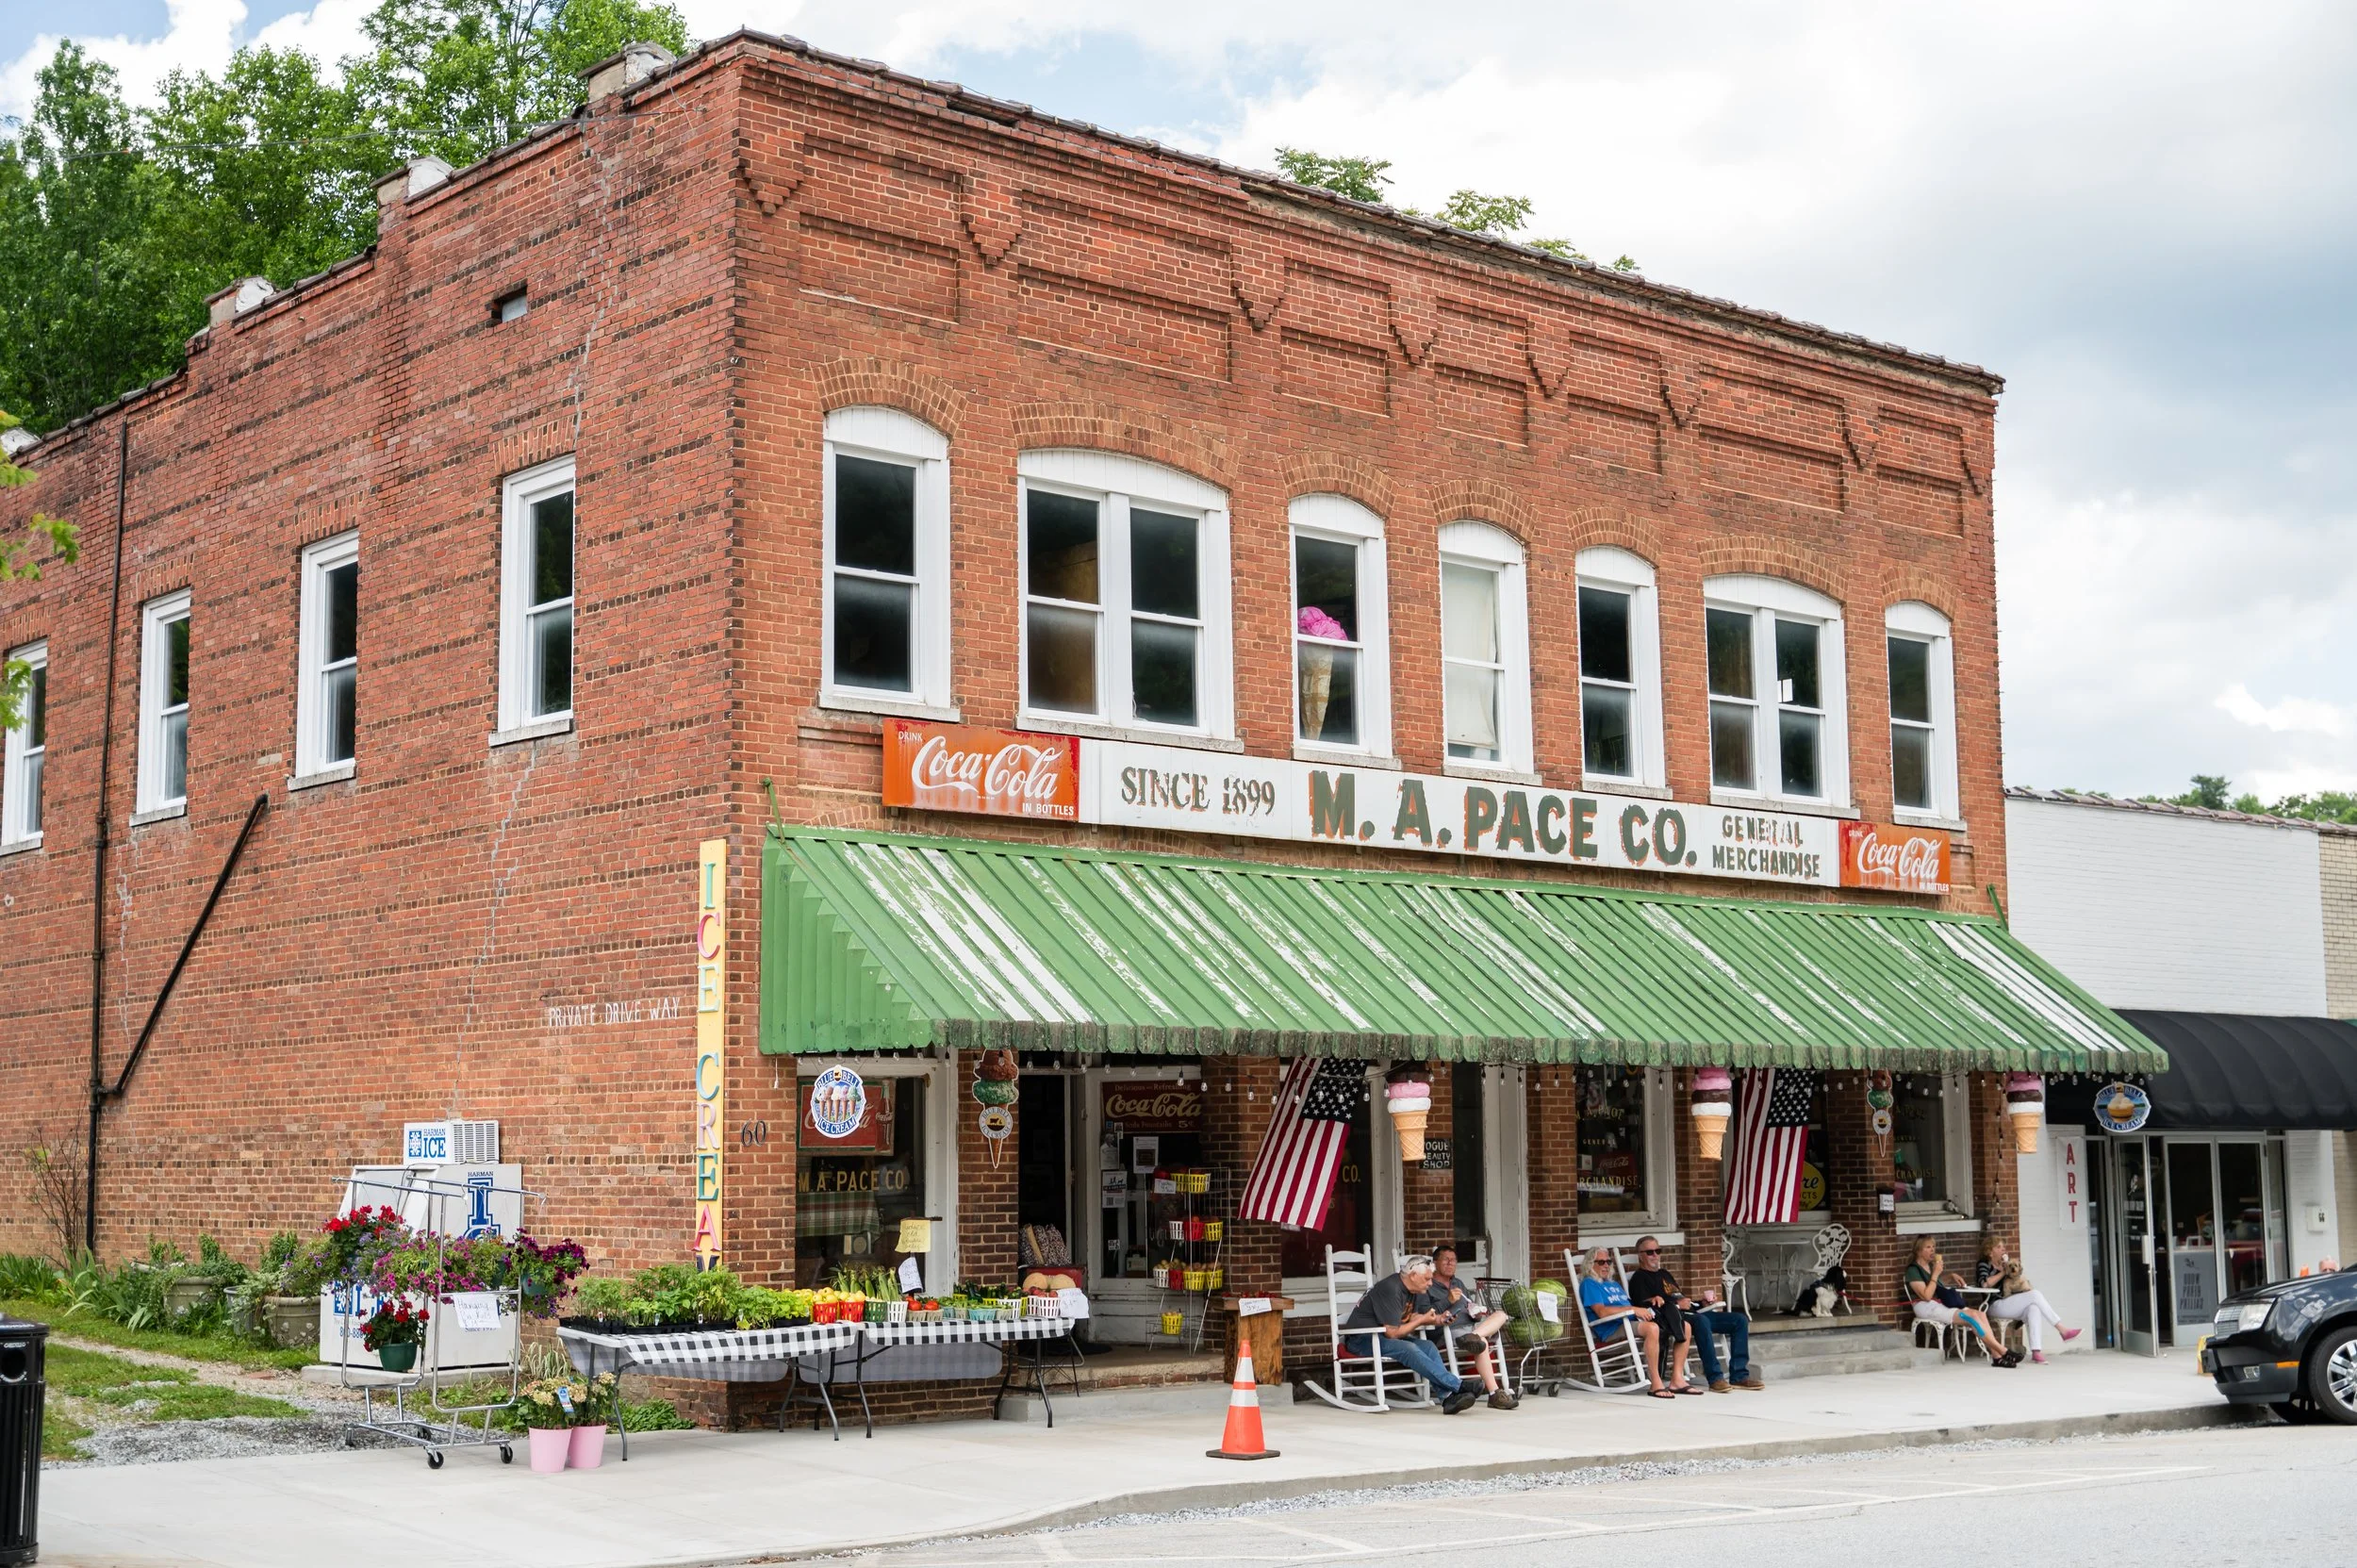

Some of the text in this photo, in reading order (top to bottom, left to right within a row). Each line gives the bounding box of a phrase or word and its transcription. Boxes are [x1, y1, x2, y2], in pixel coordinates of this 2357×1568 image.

[898, 731, 922, 741] DRINK
[912, 735, 1063, 800] Coca-Cola
[1121, 766, 1275, 817] SINCE 1899
[1022, 802, 1074, 816] IN BOTTLES
[1309, 769, 1697, 868] M. A. PACE CO.
[1722, 815, 1803, 848] GENERAL
[1849, 830, 1863, 838] DRINK
[1712, 845, 1820, 880] MERCHANDISE
[1857, 833, 1942, 879] Coca-Cola
[1919, 882, 1949, 892] IN BOTTLES
[696, 861, 720, 1014] ICE
[549, 996, 680, 1028] PRIVATE DRIVE WAY
[816, 1070, 860, 1088] BLUE BELL
[1105, 1092, 1201, 1118] Coca-Cola
[422, 1128, 446, 1136] HARMAN
[741, 1118, 766, 1147] 60
[818, 1117, 830, 1132] ICE
[831, 1118, 856, 1134] CREAM
[422, 1137, 446, 1158] ICE
[1425, 1141, 1448, 1151] OGUE
[1426, 1152, 1451, 1161] EAUTY
[1342, 1164, 1361, 1183] CO.
[1423, 1160, 1450, 1169] SHOP
[836, 1169, 880, 1192] PACE
[885, 1169, 908, 1191] CO.
[1576, 1174, 1642, 1188] RCHANDISE.
[2066, 1143, 2078, 1223] ART
